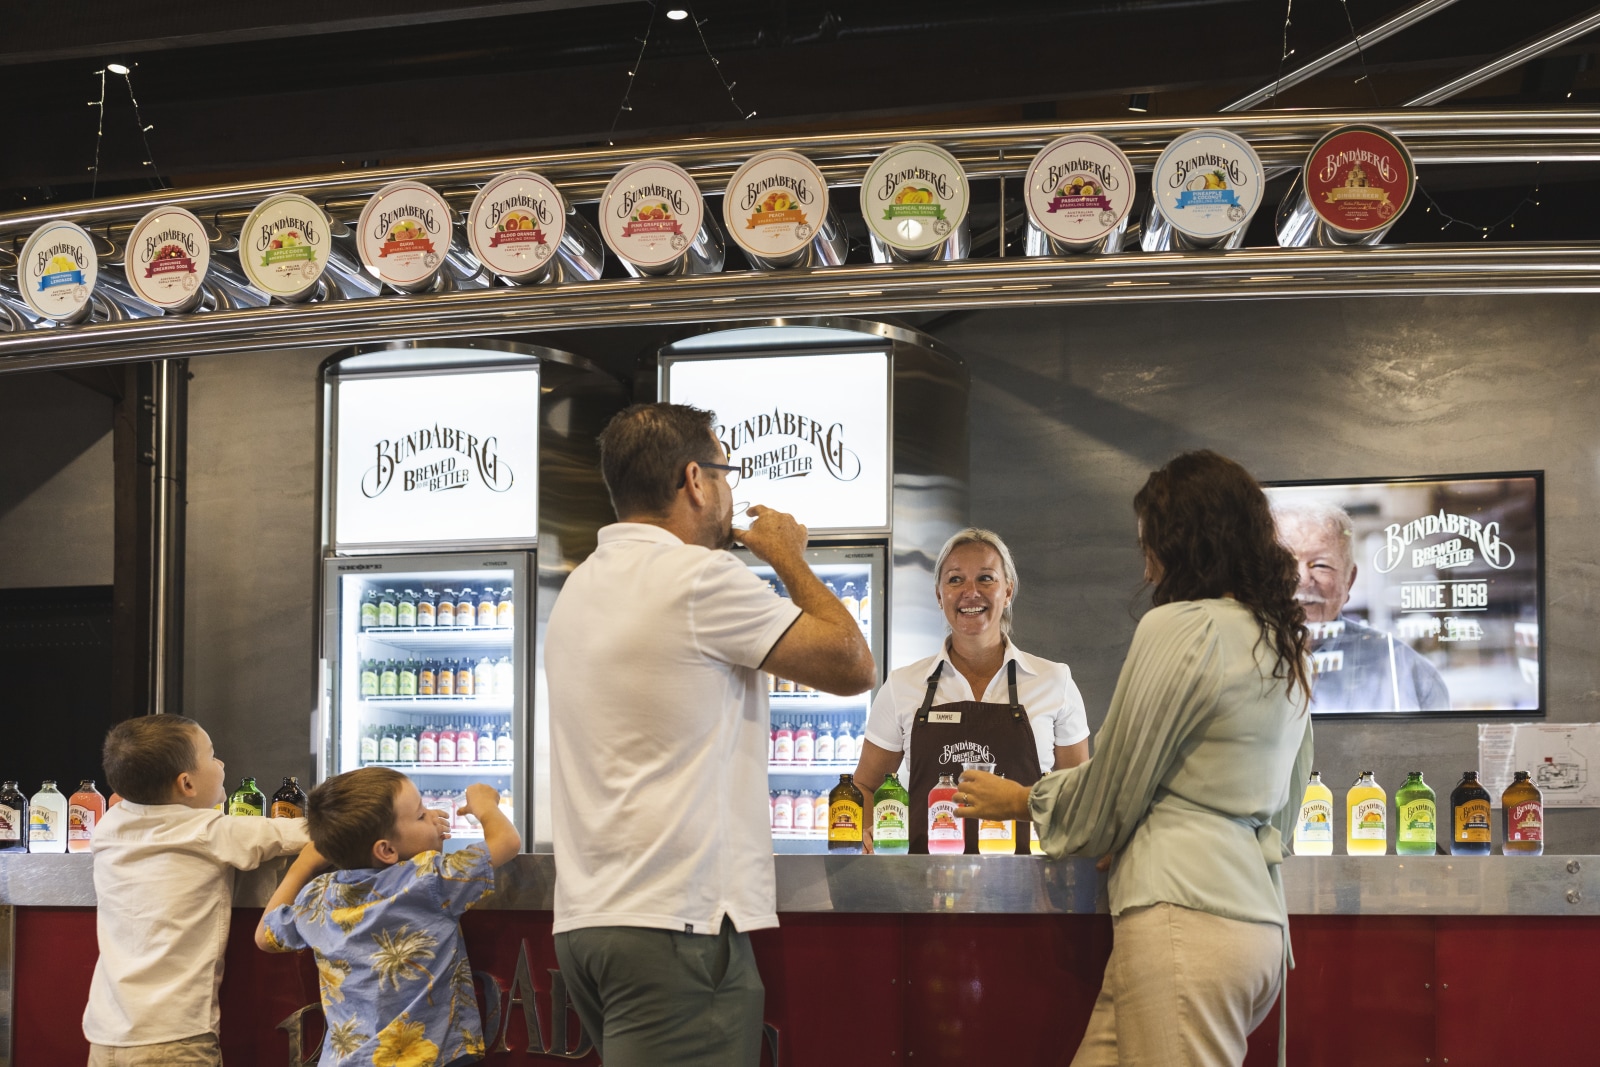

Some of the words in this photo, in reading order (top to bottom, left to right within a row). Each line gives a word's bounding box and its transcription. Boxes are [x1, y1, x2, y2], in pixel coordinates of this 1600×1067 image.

[1042, 156, 1119, 194] BUNDABERG
[1169, 152, 1247, 189] BUNDABERG
[1320, 147, 1398, 183] BUNDABERG
[617, 183, 689, 218] BUNDABERG
[741, 173, 814, 211] BUNDABERG
[878, 165, 954, 201] BUNDABERG
[374, 203, 441, 240] BUNDABERG
[485, 193, 553, 230] BUNDABERG
[141, 228, 200, 263] BUNDABERG
[256, 216, 320, 251] BUNDABERG
[34, 241, 89, 277] BUNDABERG
[51, 277, 72, 285] LEMONADE
[361, 421, 514, 499] BUNDABERG
[404, 457, 456, 492] BREWED
[741, 443, 798, 480] BREWED
[769, 456, 813, 481] BETTER
[429, 469, 469, 492] BETTER
[1373, 507, 1516, 574] BUNDABERG
[1412, 538, 1462, 569] BREWED
[1436, 548, 1475, 570] BETTER
[1401, 584, 1446, 609] SINCE
[1451, 583, 1488, 608] 1968
[938, 739, 996, 765] BUNDABERG
[952, 750, 975, 763] BREWED
